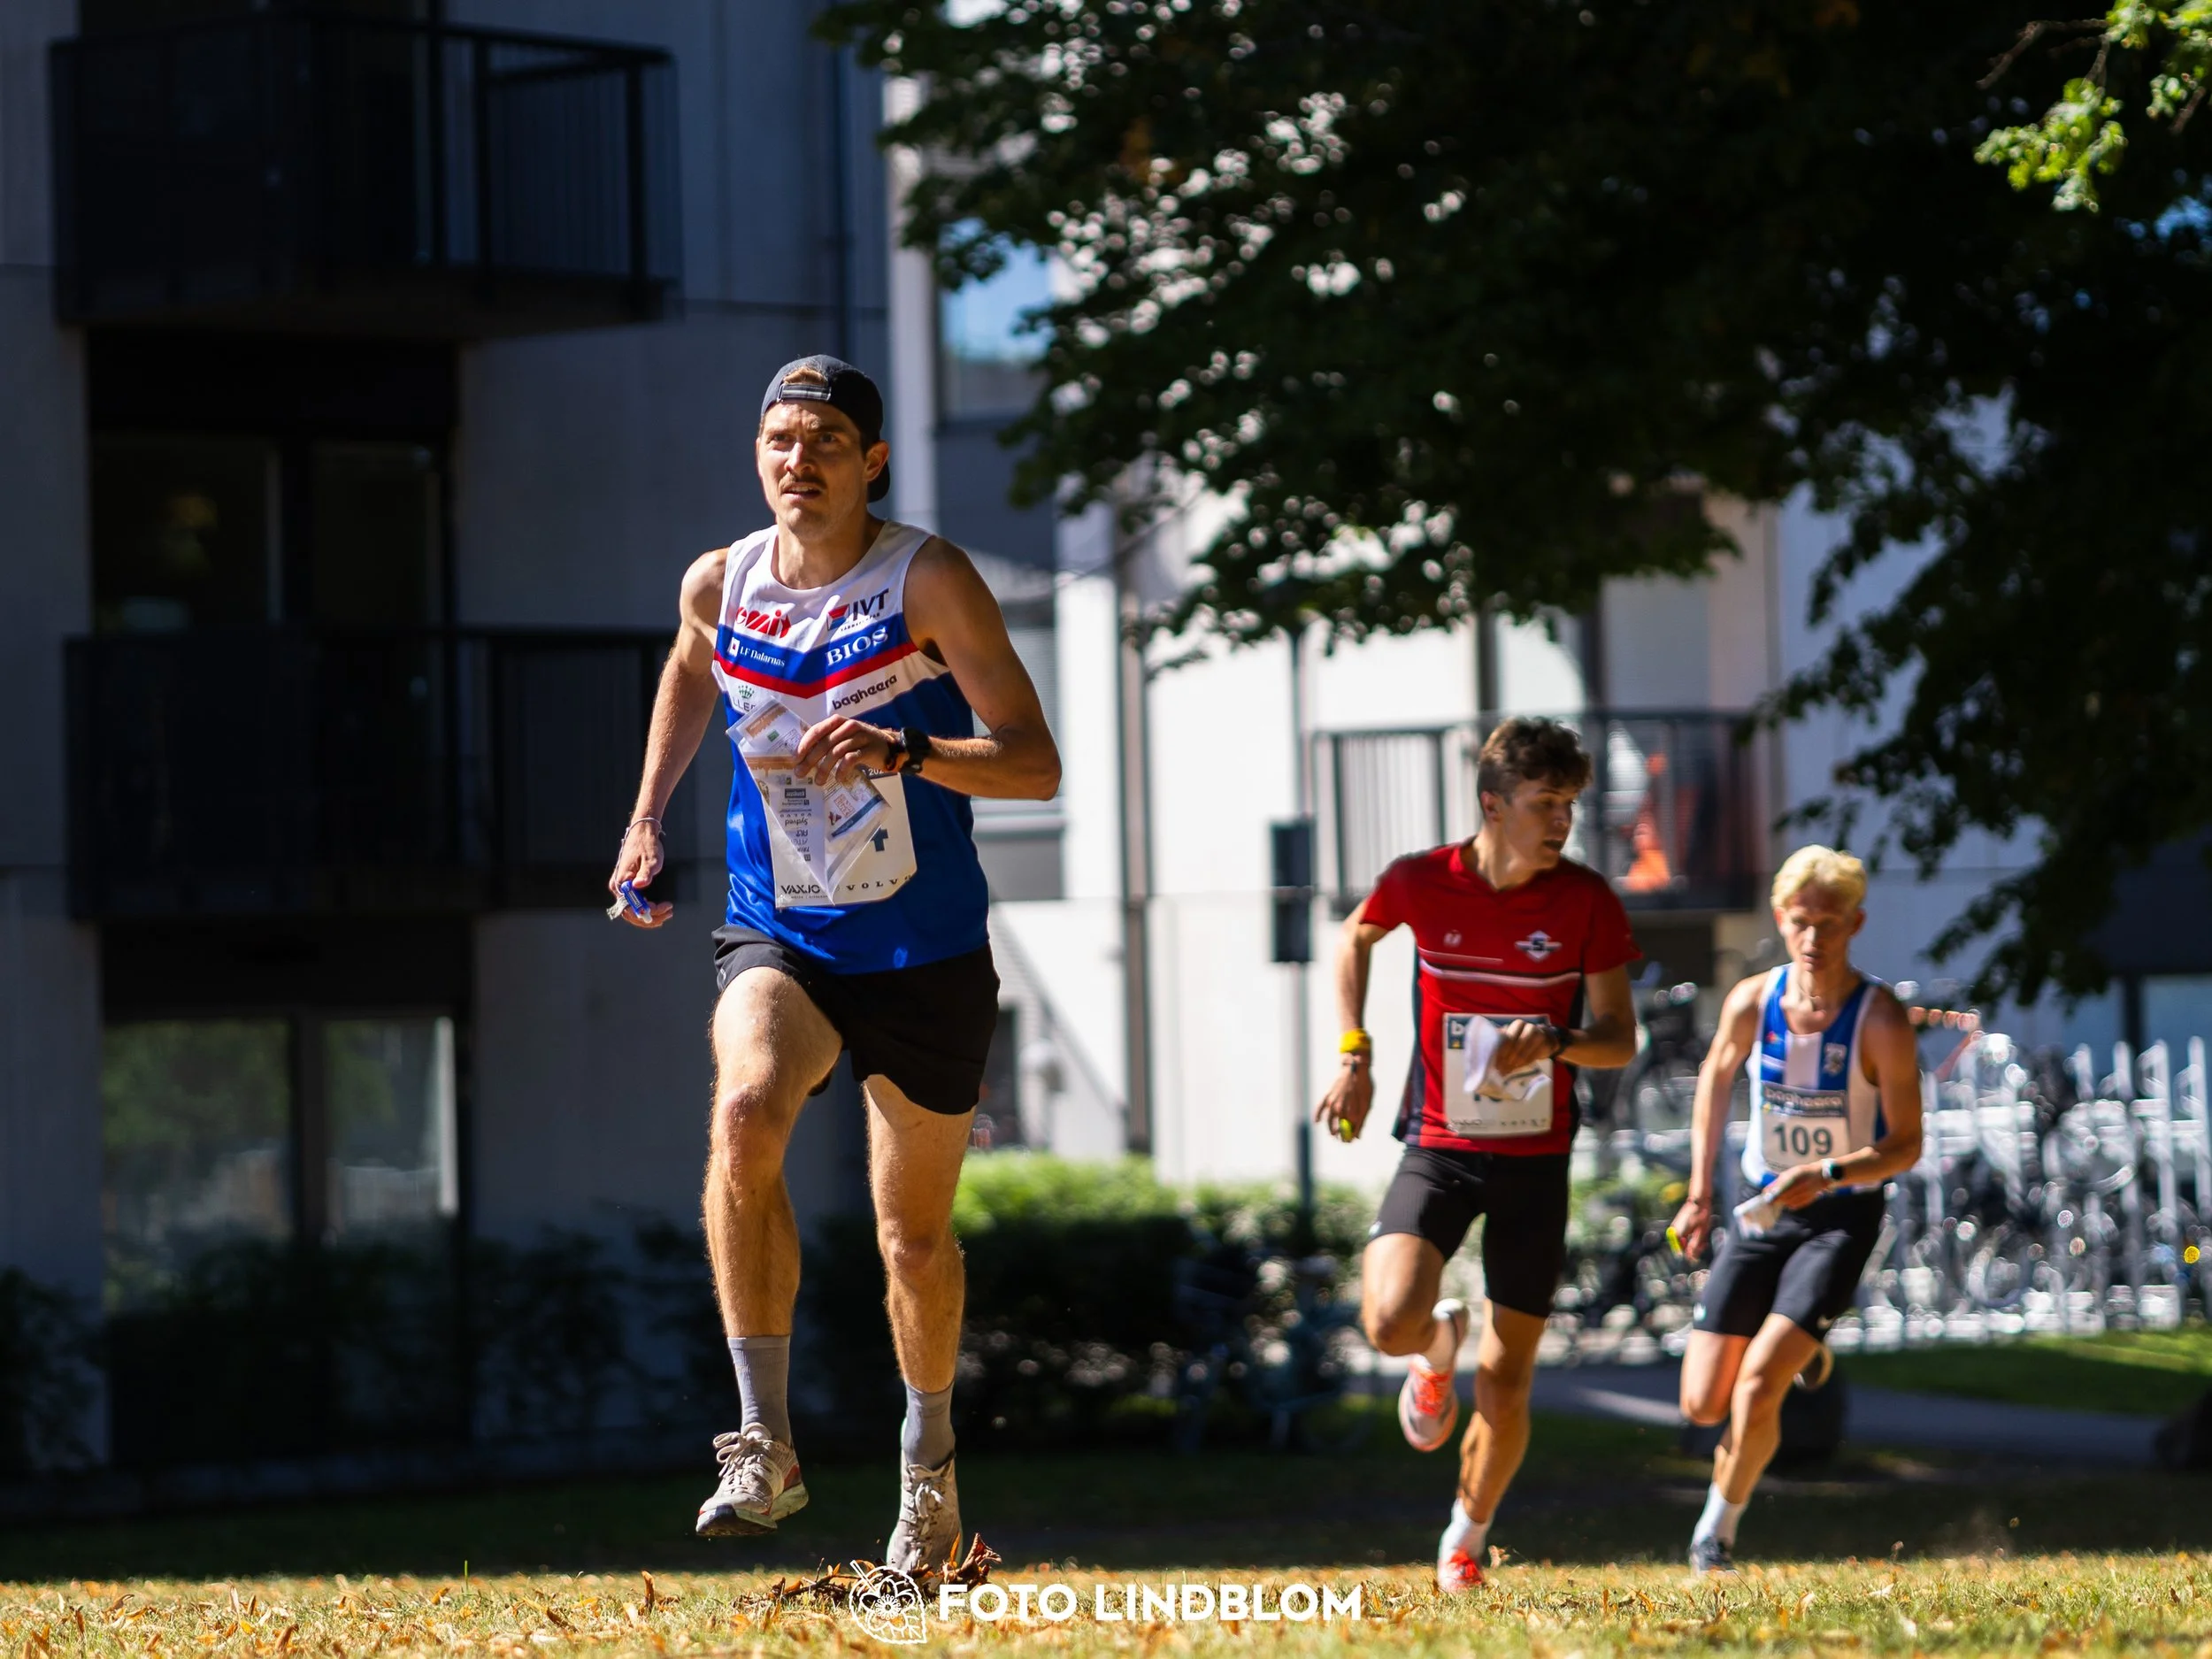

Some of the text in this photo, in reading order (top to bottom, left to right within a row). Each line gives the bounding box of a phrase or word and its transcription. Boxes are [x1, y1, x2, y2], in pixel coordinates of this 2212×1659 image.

[852, 588, 889, 621] IVT
[750, 649, 786, 667] Dalarnas
[825, 625, 888, 666] BIOS
[832, 673, 897, 710] bagheera
[1773, 1122, 1833, 1156] 109
